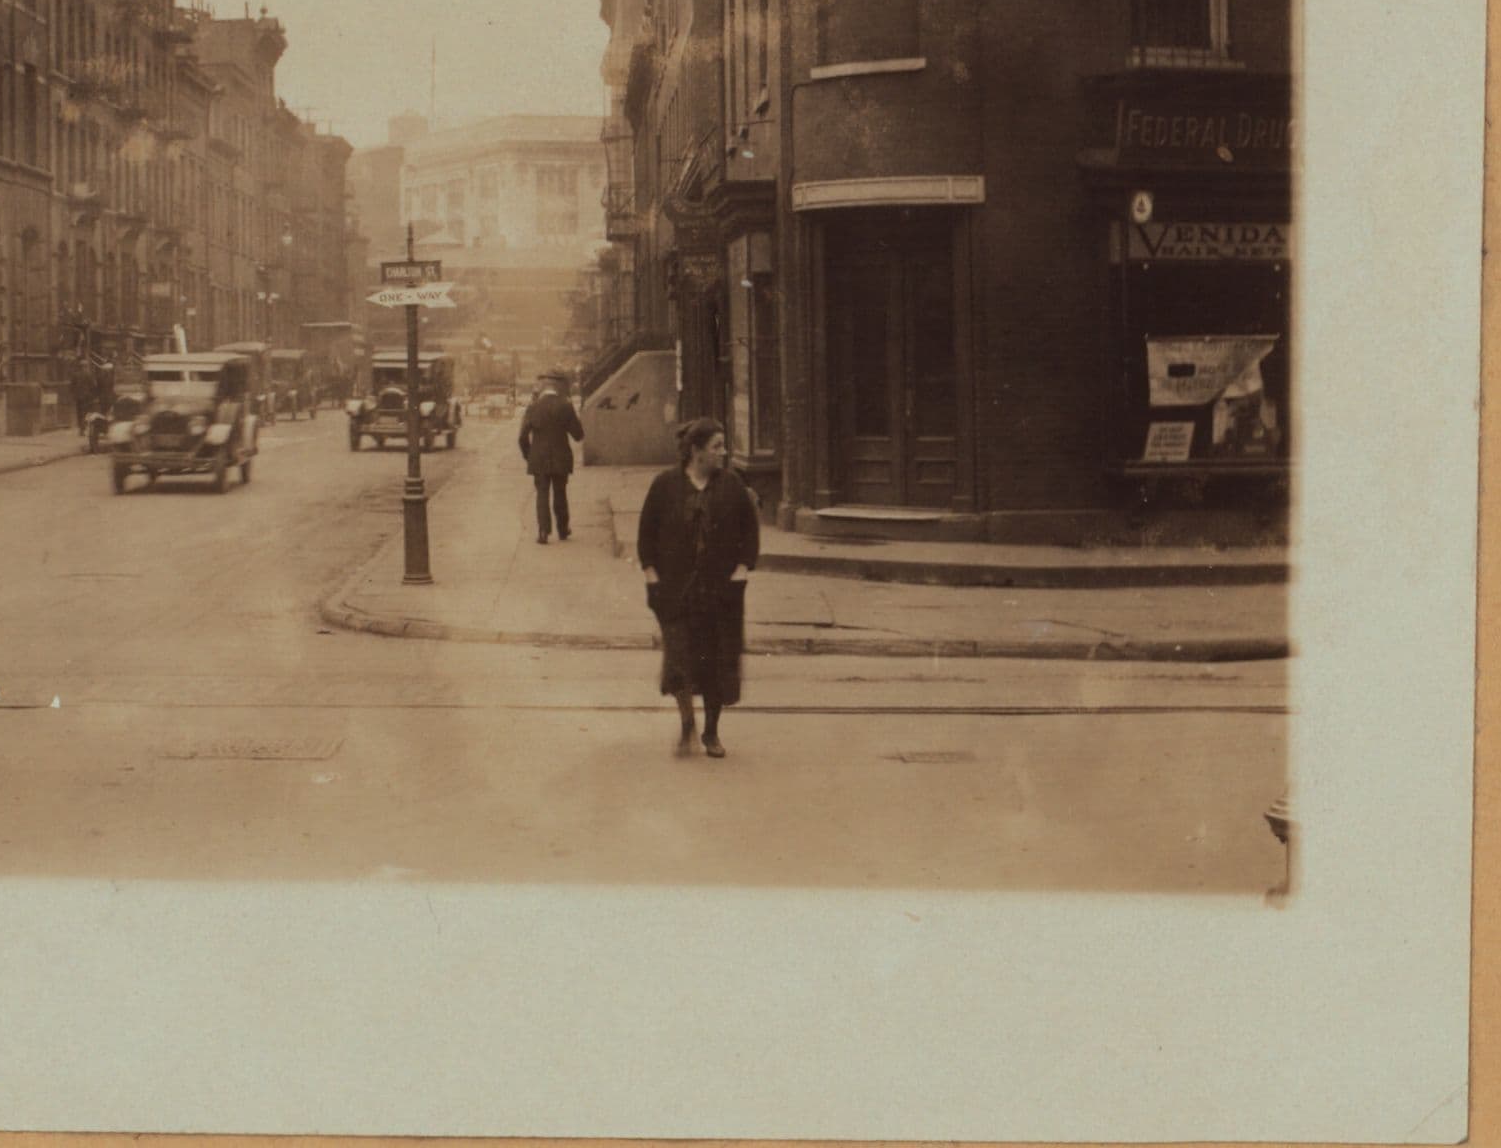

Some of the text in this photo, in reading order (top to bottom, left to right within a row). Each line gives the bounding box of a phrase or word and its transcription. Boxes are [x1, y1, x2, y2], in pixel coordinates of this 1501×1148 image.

[1126, 109, 1229, 149] FEDERAL
[1136, 224, 1285, 257] VENIDA
[416, 291, 442, 300] WAY
